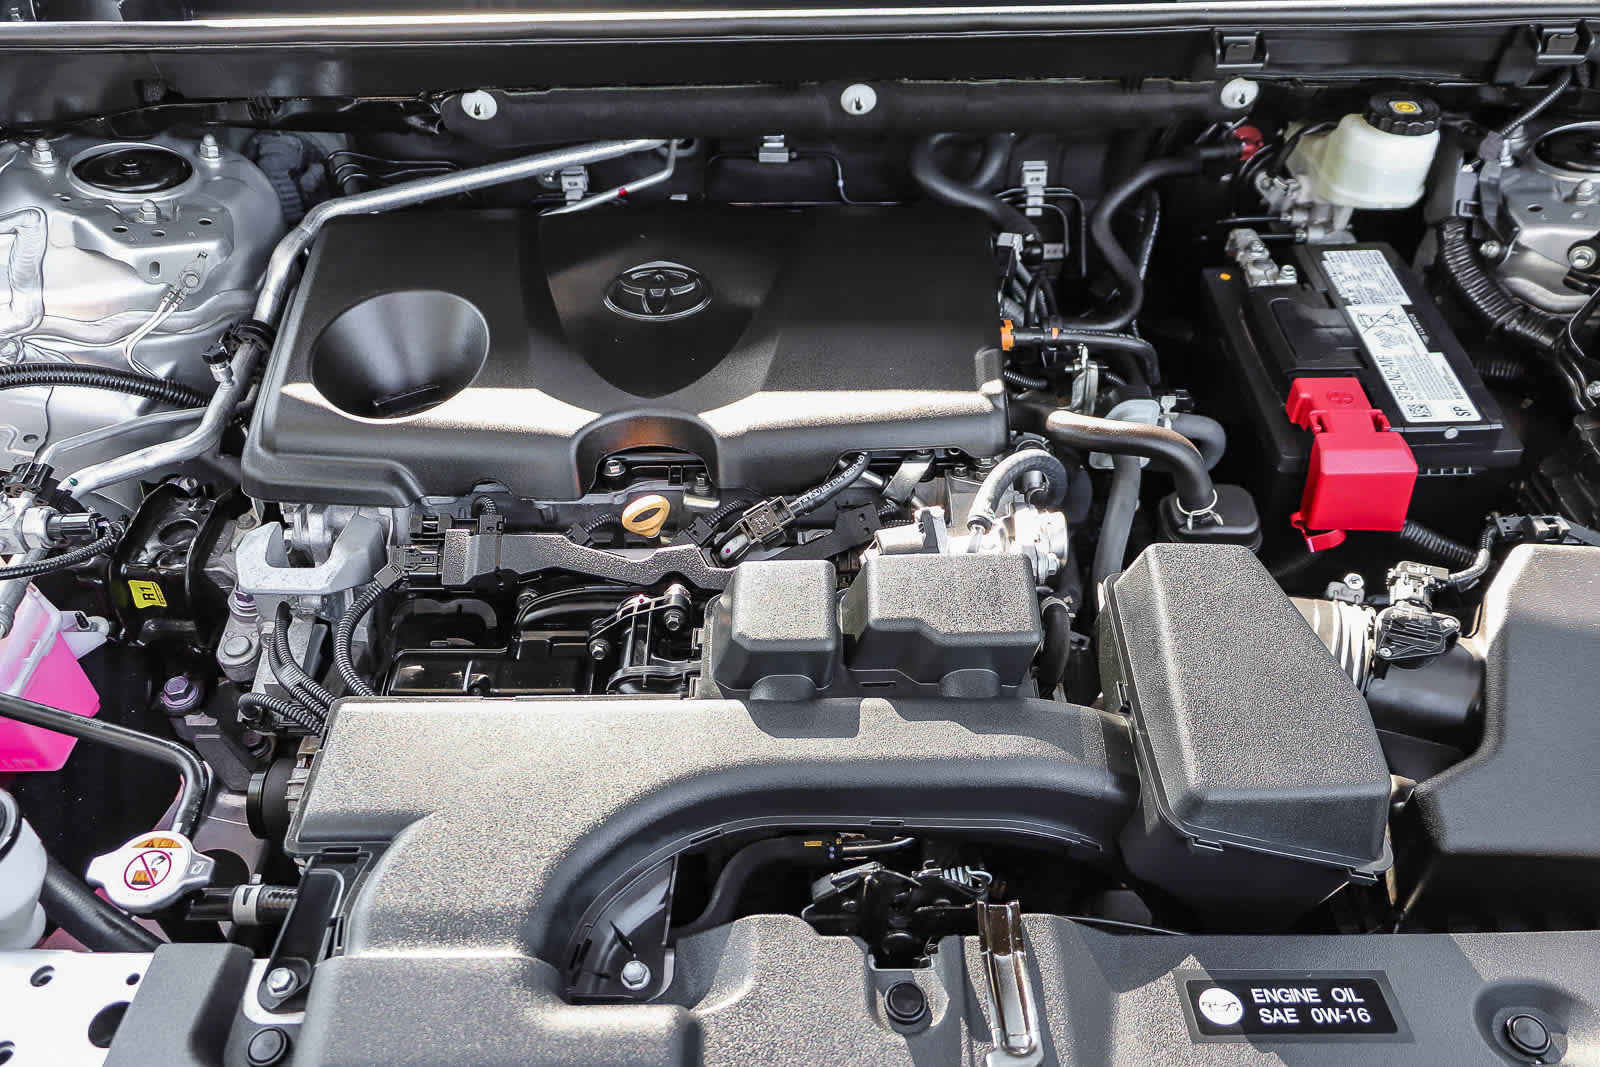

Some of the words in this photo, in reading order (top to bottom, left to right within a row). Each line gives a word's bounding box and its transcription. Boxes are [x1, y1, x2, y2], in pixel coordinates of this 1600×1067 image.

[1453, 406, 1471, 417] SP
[1251, 988, 1321, 1003] ENGINE
[1330, 988, 1364, 1003] OIL
[1258, 1008, 1300, 1023] SAE
[1310, 1008, 1371, 1024] 0W-16
